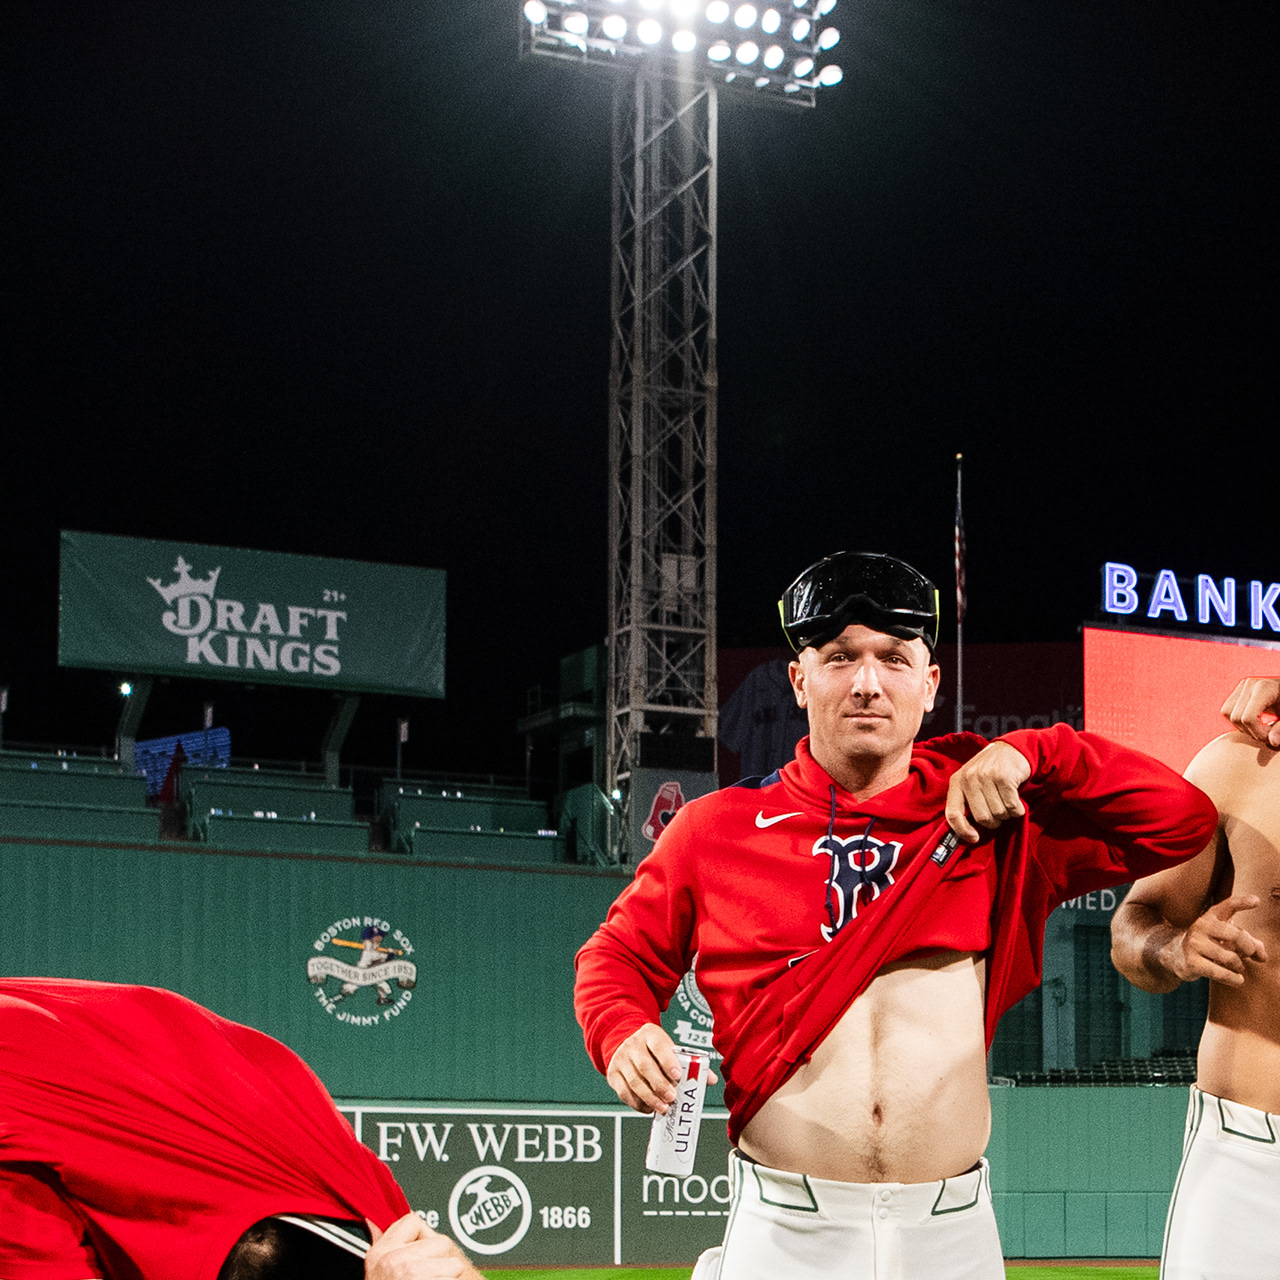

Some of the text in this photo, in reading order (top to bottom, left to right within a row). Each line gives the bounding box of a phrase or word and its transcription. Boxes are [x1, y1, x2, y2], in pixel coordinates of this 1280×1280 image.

[322, 588, 347, 602] 21+
[162, 595, 347, 641] DRAFT
[186, 630, 341, 677] KINGS
[313, 916, 415, 955] BOSTON RED SOX
[311, 962, 360, 981] TOGETHER
[362, 967, 389, 981] SINCE
[314, 987, 412, 1026] THE JIMMY FUND
[687, 1033, 708, 1044] 125
[675, 1087, 698, 1153] ULTRA
[376, 1122, 603, 1163] F.W. WEBB
[470, 1193, 513, 1227] WEBB
[539, 1206, 591, 1228] 1866
